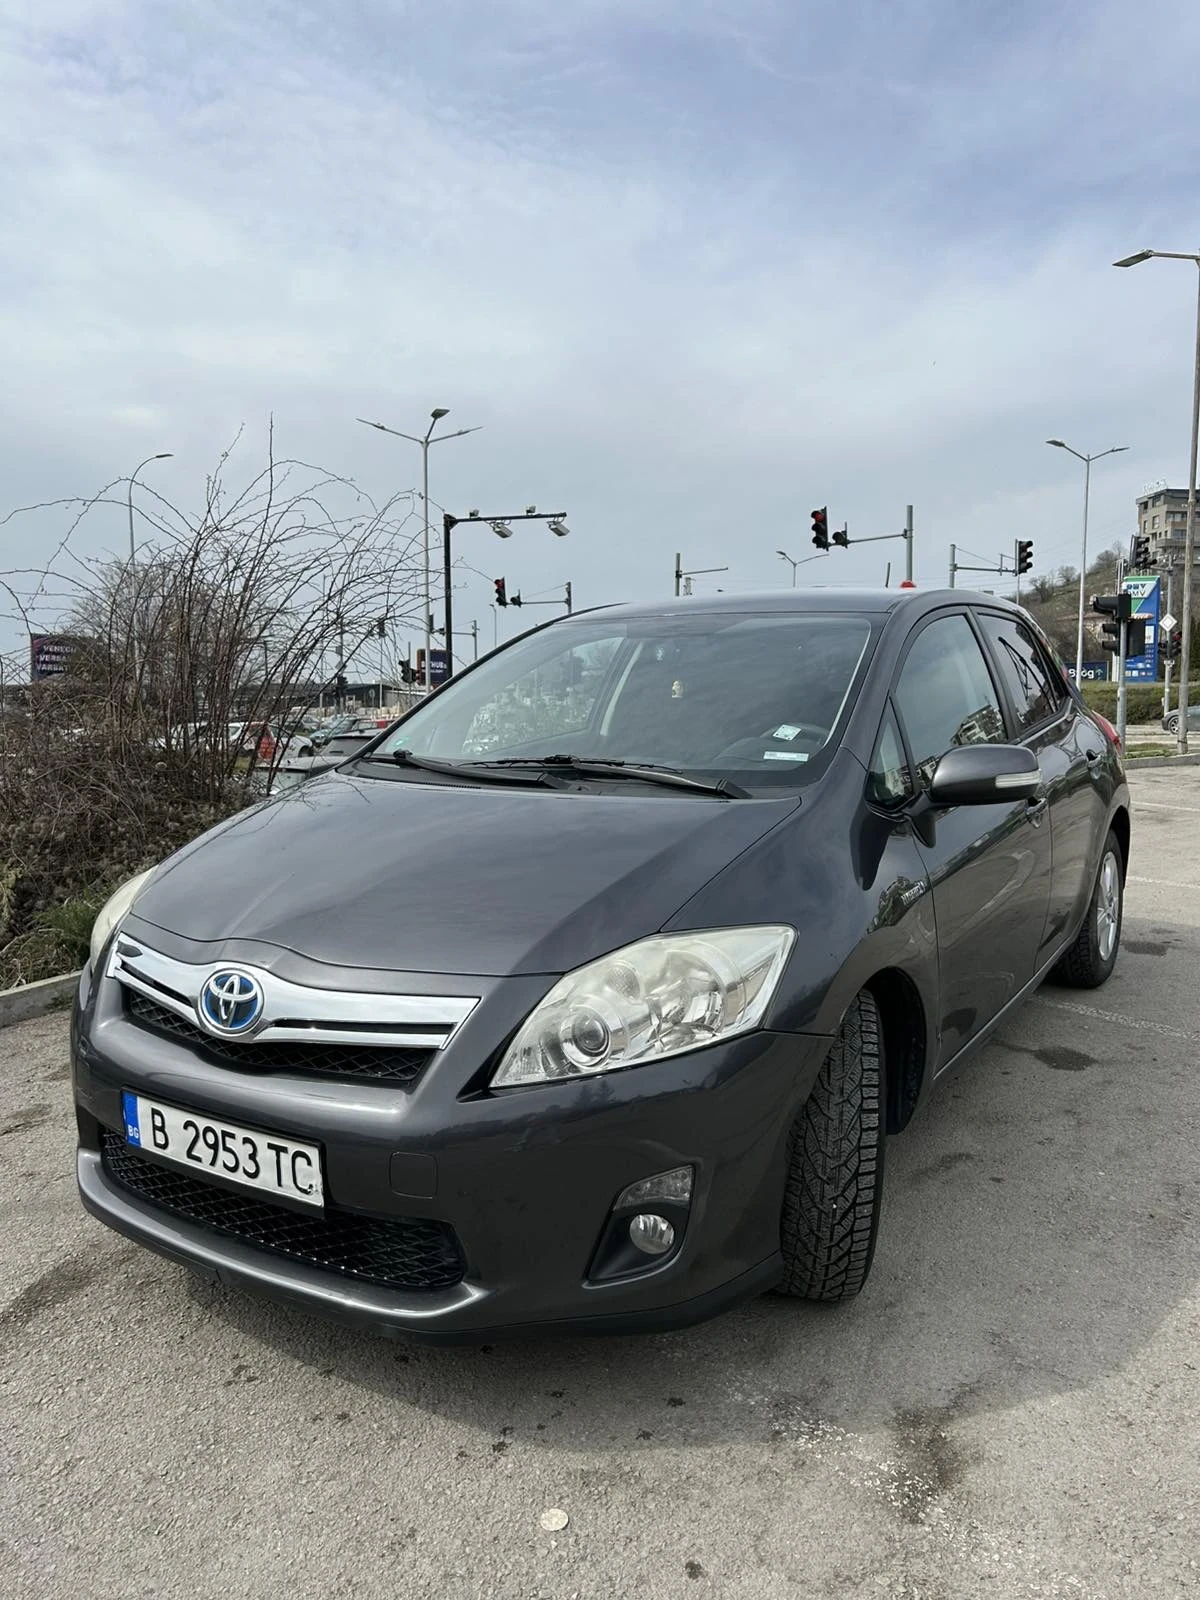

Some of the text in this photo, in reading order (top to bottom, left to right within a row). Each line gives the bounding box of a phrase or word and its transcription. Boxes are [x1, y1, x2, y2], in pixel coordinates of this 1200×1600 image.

[127, 1124, 140, 1139] BG
[151, 1107, 314, 1195] B 2953 TC
